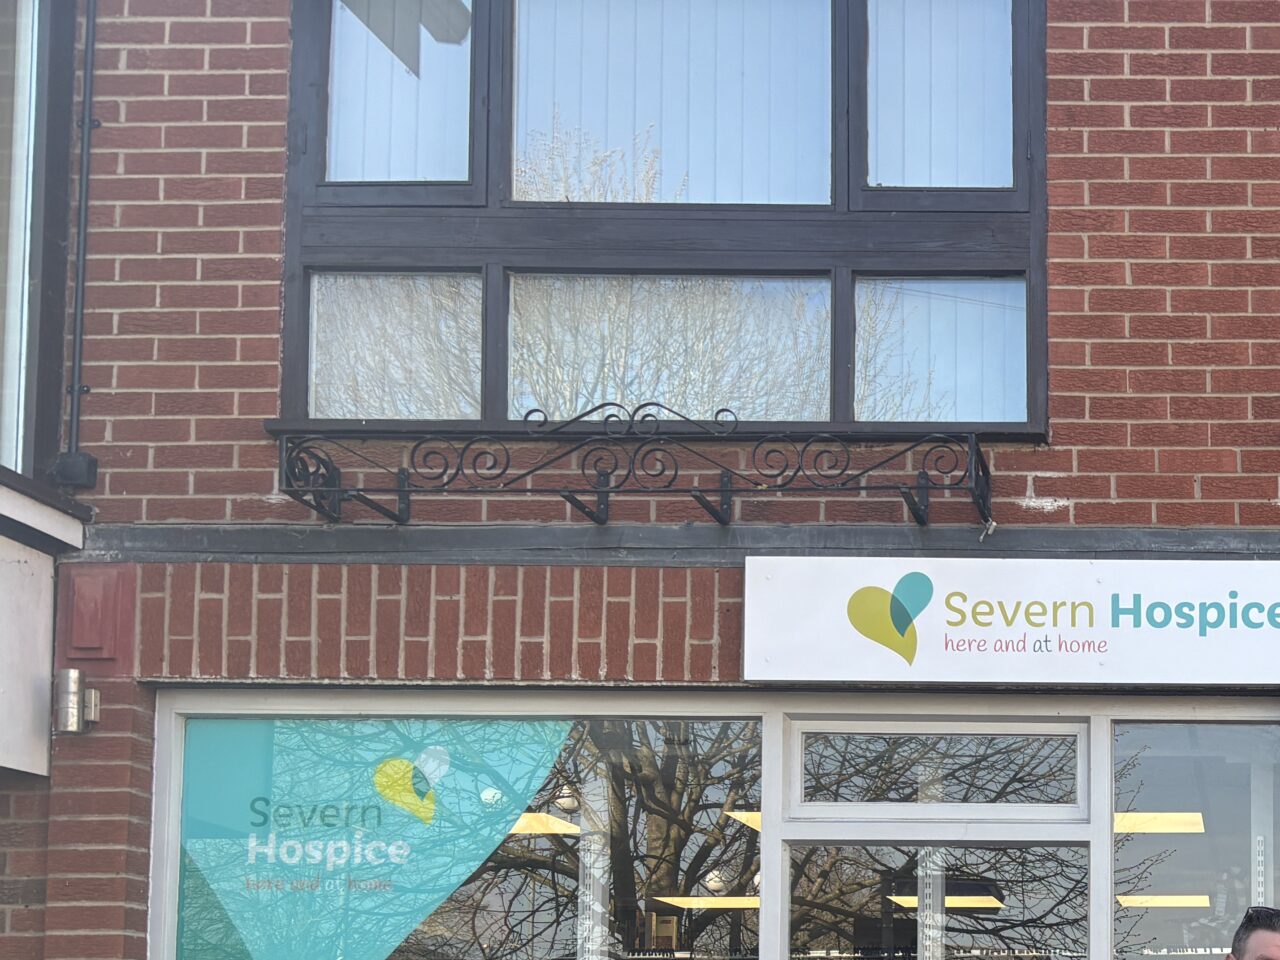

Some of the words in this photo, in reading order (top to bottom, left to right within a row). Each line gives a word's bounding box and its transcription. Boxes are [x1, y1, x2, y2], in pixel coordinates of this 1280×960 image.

[945, 590, 1096, 629] Severn
[944, 632, 988, 653] here
[993, 632, 1027, 654] and
[1033, 633, 1054, 654] at
[1058, 632, 1109, 654] home
[250, 797, 382, 828] Severn
[247, 830, 411, 871] Hospice
